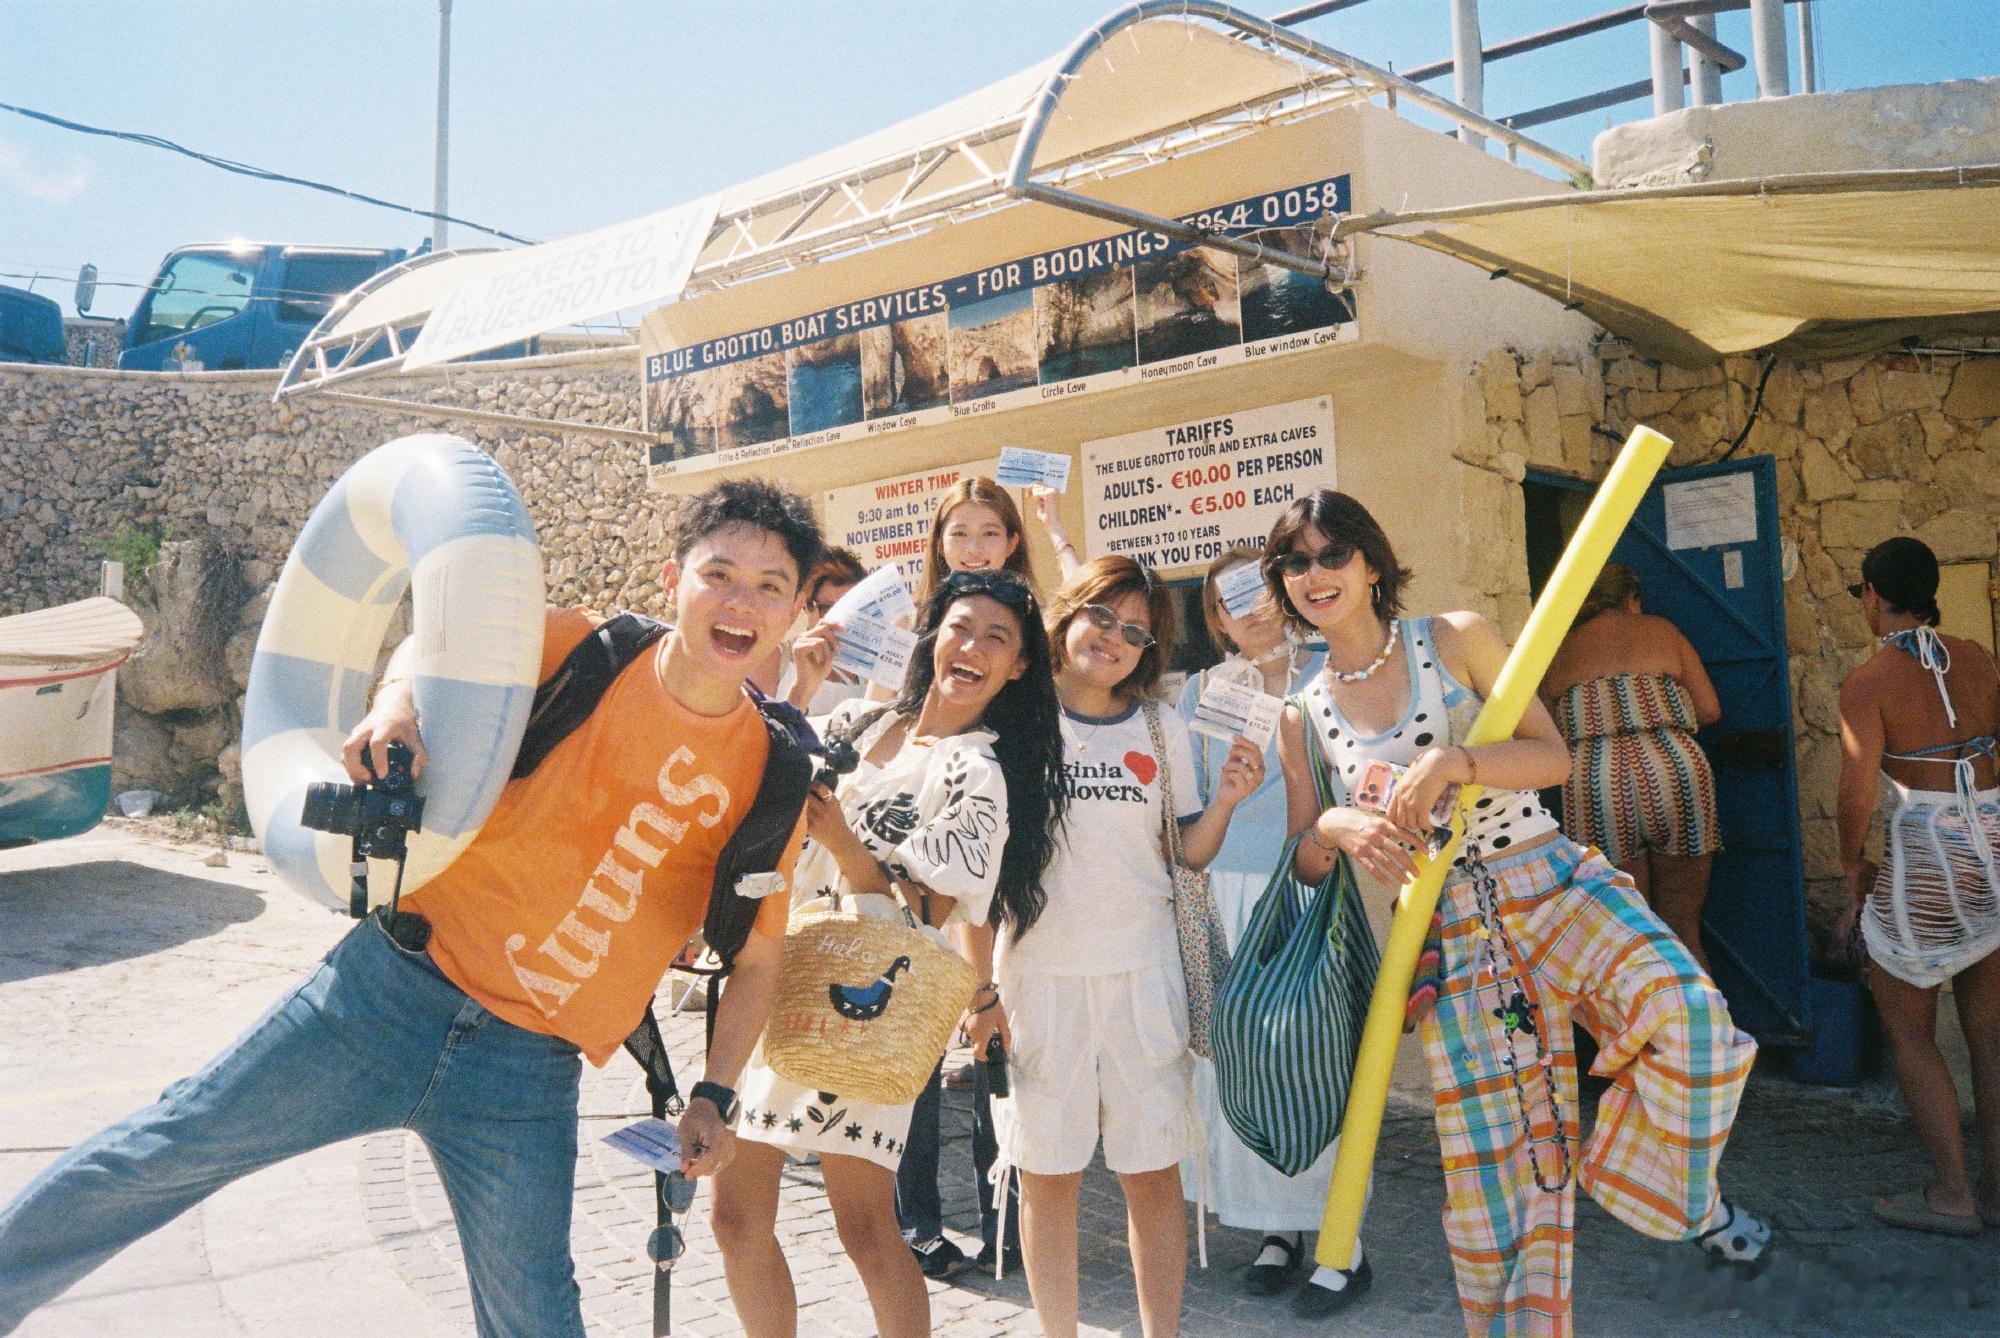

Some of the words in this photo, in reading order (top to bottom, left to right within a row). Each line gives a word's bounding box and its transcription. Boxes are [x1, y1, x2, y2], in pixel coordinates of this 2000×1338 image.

[484, 240, 606, 302] TICKETS
[613, 224, 656, 260] TO
[651, 348, 694, 377] BLUE
[703, 331, 773, 363] GROTTO
[782, 315, 827, 345] BOAT
[836, 285, 947, 330] SERVICES
[977, 268, 1021, 298] FOR
[1033, 229, 1170, 281] BOOKINGS
[1263, 183, 1338, 223] 0058
[443, 298, 525, 348] BLUE
[529, 256, 657, 321] GROTTO
[1245, 343, 1267, 358] Blue
[1270, 335, 1311, 353] window
[1314, 330, 1337, 347] Cave
[1141, 359, 1194, 380] Honeymoon
[1197, 355, 1218, 370] Cave
[1041, 385, 1066, 399] Circle
[1067, 381, 1087, 395] Cave
[954, 404, 970, 417] Blue
[972, 400, 996, 415] Grotto
[867, 418, 897, 433] Window
[899, 415, 917, 430] Cave
[1166, 418, 1234, 447] TARIFFS
[792, 436, 825, 449] Reflection
[826, 431, 841, 443] Cave
[1096, 461, 1114, 476] THE
[1117, 456, 1142, 472] BLUE
[1144, 450, 1185, 468] GROTTO
[1188, 444, 1216, 460] TOUR
[1219, 439, 1240, 455] AND
[1243, 433, 1278, 451] EXTRA
[1281, 425, 1317, 442] CAVES
[1171, 463, 1231, 490] €10.00
[1237, 457, 1263, 479] PER
[1267, 448, 1323, 473] PERSON
[875, 479, 923, 500] WINTER
[1189, 490, 1246, 516] €5.00
[1254, 483, 1295, 506] EACH
[858, 508, 883, 524] 9:30
[885, 506, 904, 520] am
[907, 502, 919, 516] to
[847, 521, 913, 546] NOVEMBER
[1154, 532, 1161, 545] 3
[1163, 530, 1176, 543] TO
[1177, 529, 1188, 542] 10
[1190, 524, 1221, 540] YEARS
[1161, 546, 1190, 564] YOU
[1195, 541, 1222, 560] FOR
[1059, 761, 1123, 781] ginia
[1060, 779, 1148, 804] lovers.
[504, 745, 729, 1019] Sunny
